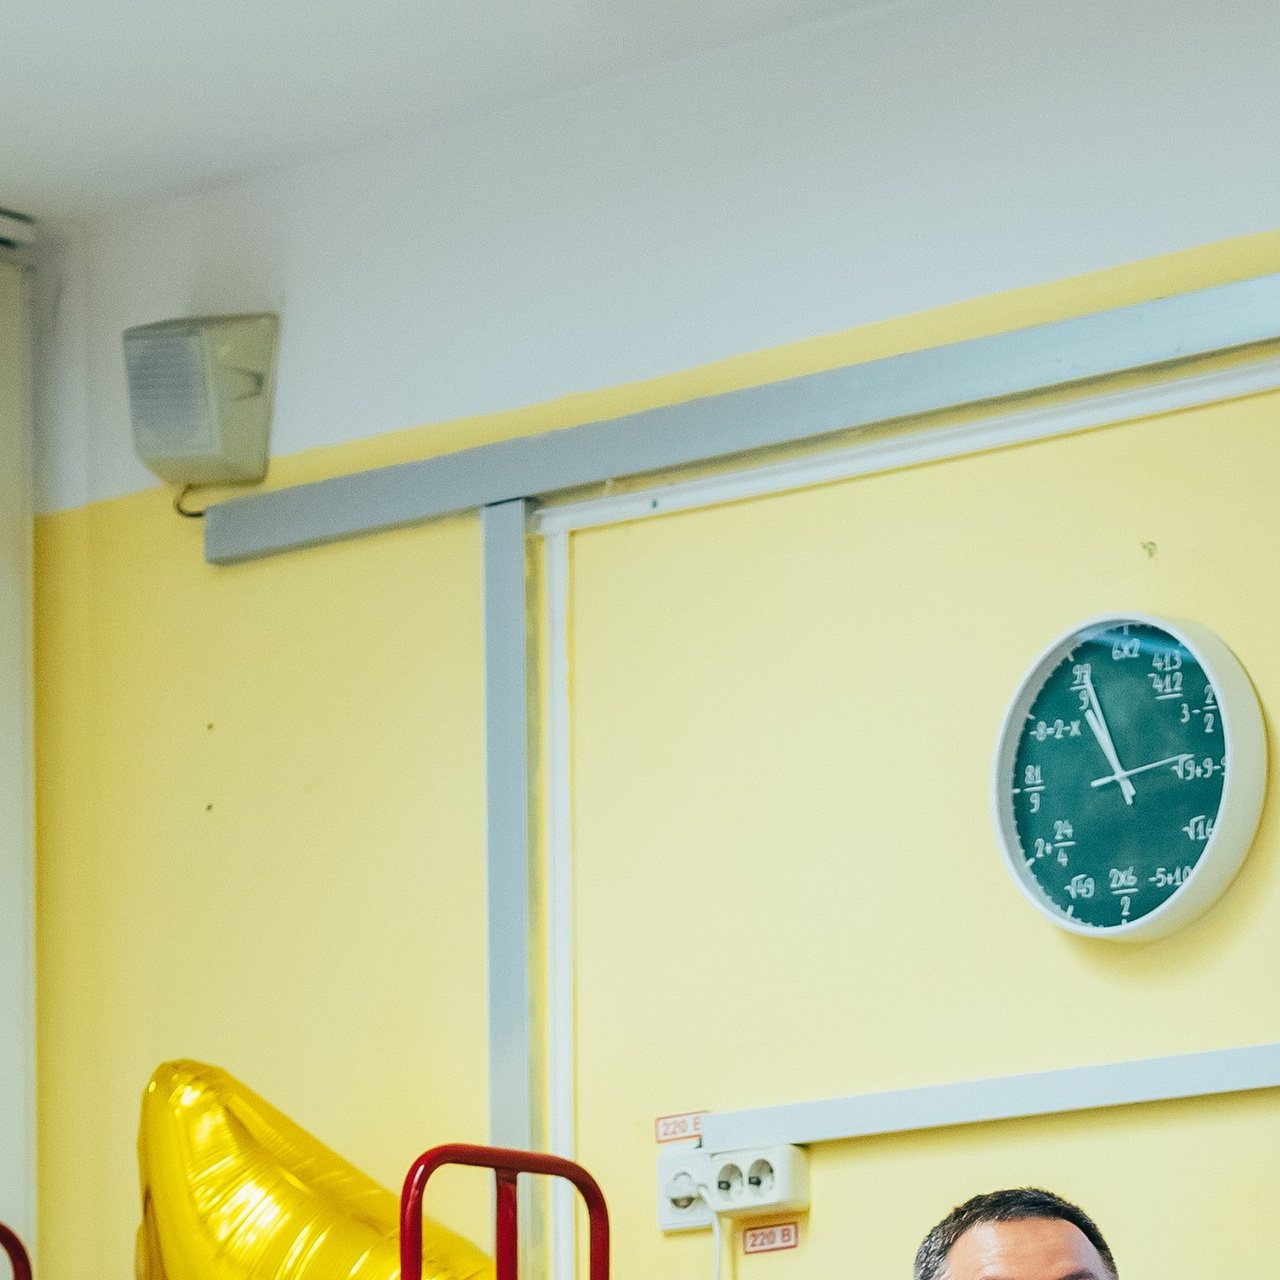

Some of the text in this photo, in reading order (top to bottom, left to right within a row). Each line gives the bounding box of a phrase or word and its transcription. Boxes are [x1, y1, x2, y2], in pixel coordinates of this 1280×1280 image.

[1152, 650, 1182, 671] 413
[1025, 765, 1043, 784] 81
[662, 1120, 688, 1136] 220
[750, 1230, 777, 1248] 220
